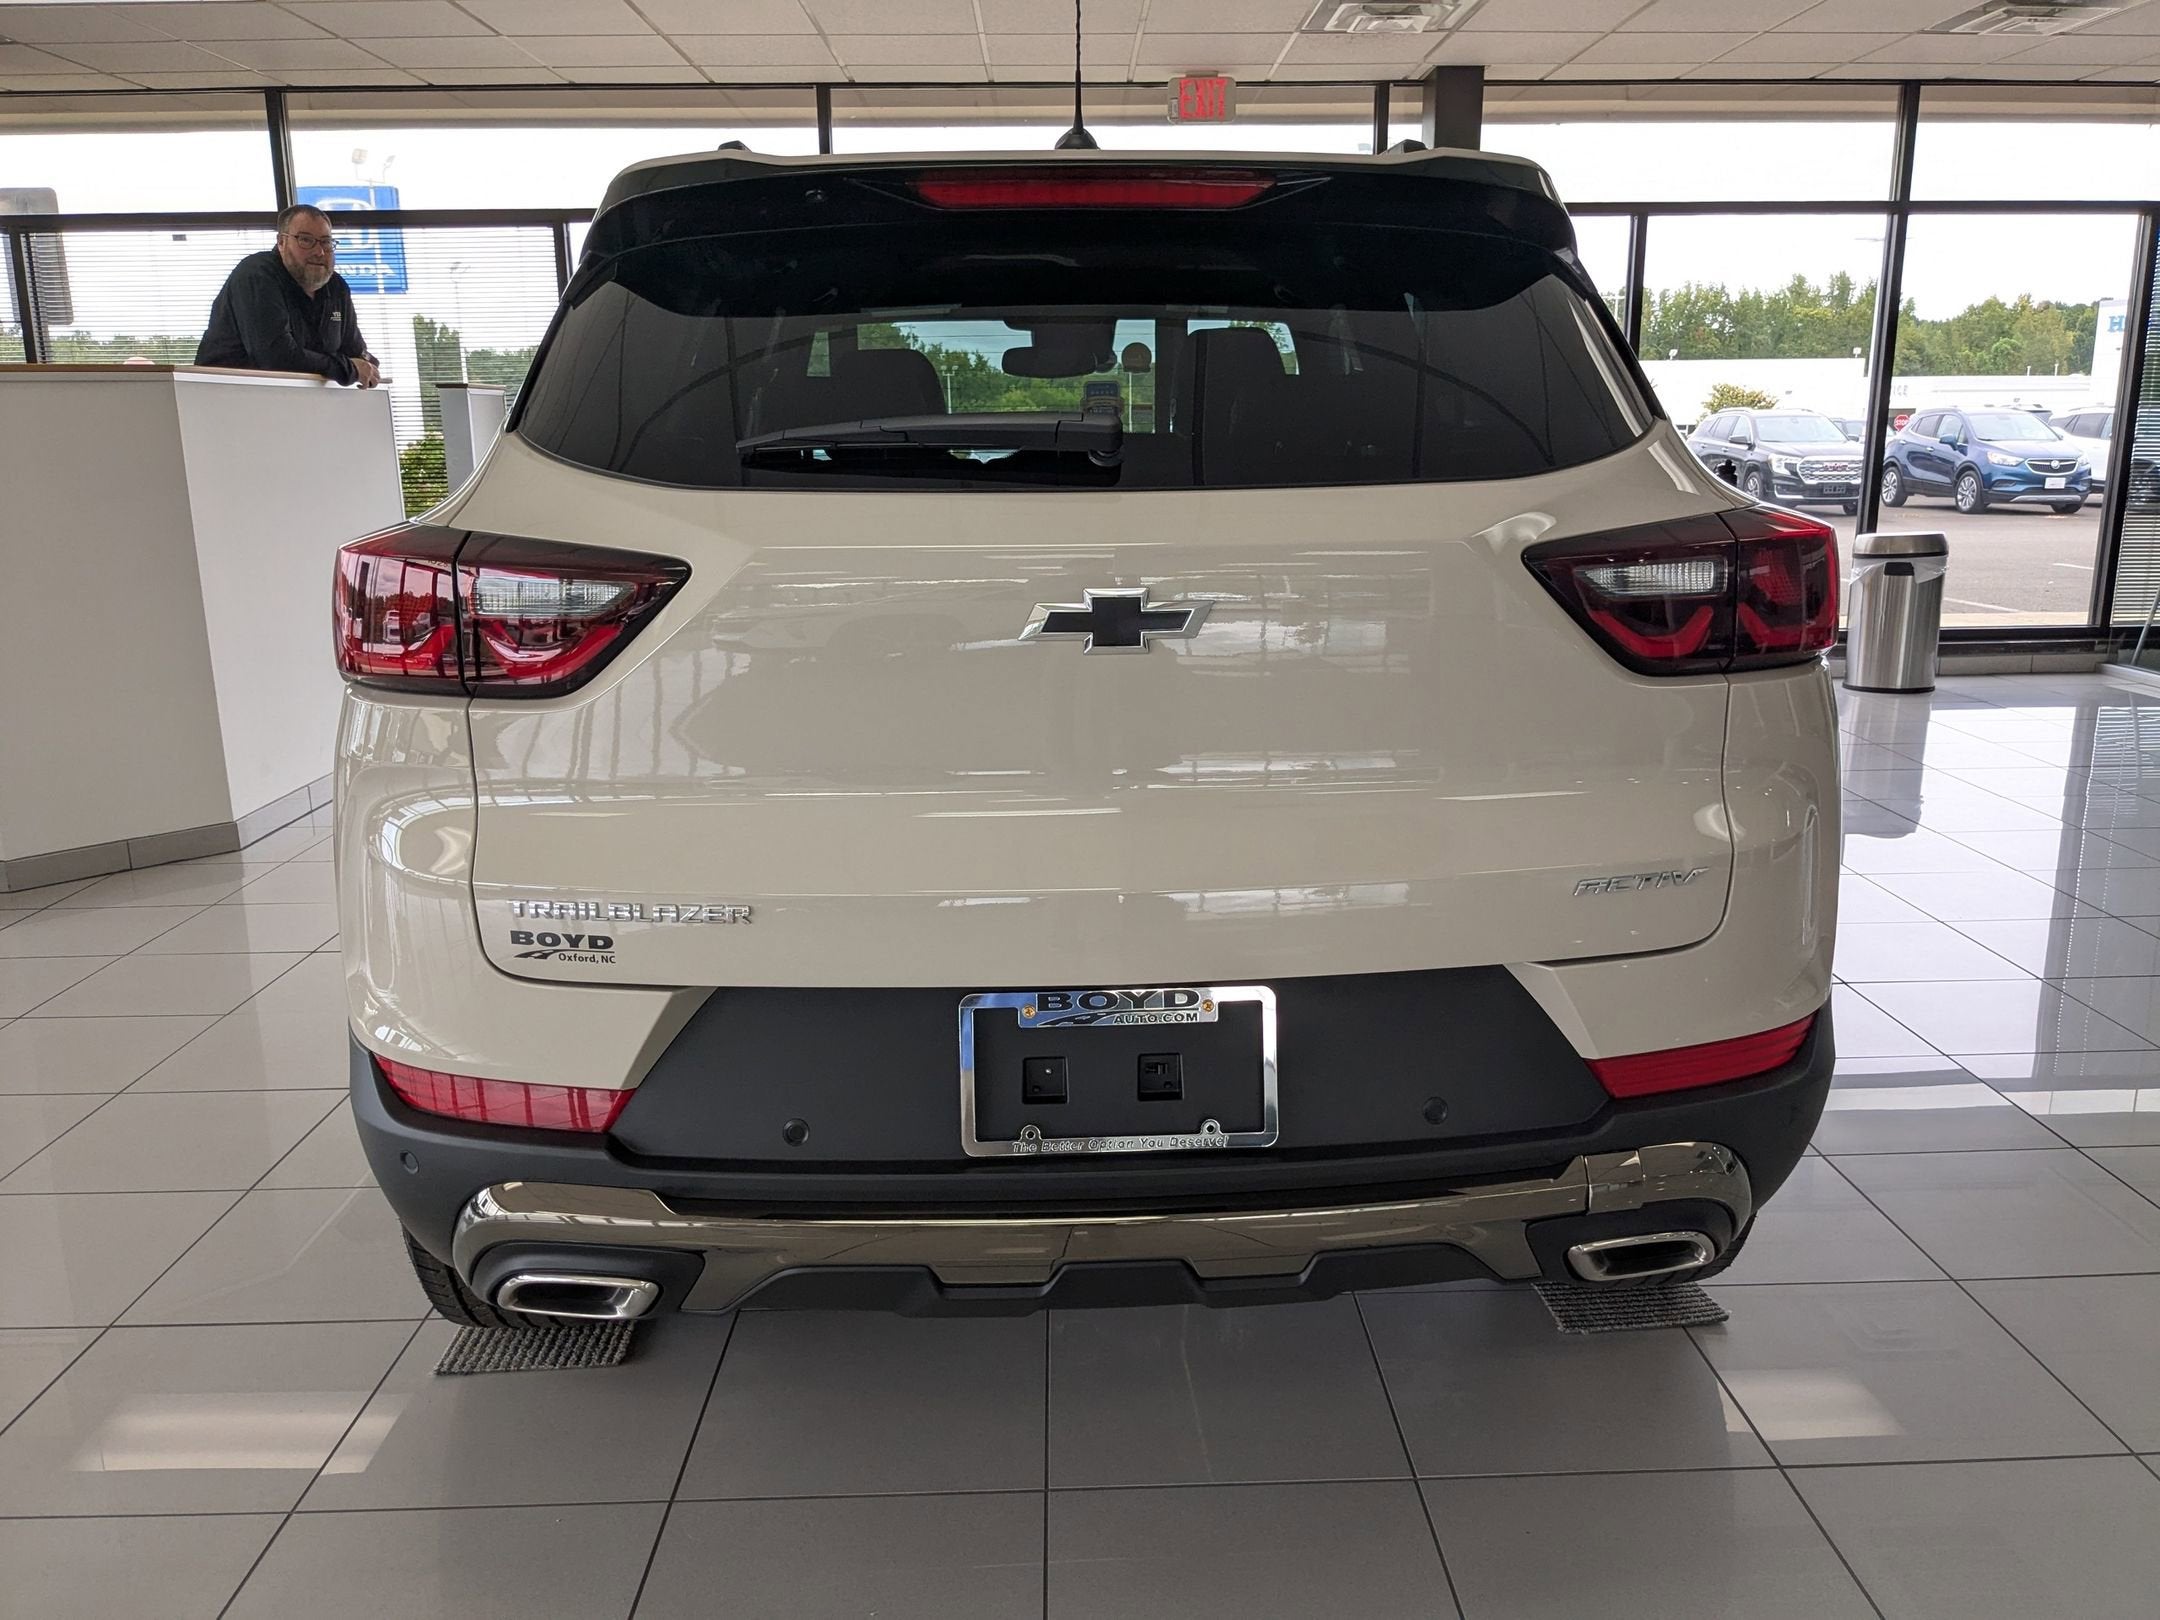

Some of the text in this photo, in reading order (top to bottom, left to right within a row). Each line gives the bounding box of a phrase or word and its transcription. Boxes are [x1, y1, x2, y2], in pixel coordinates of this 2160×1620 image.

[1180, 79, 1226, 119] EXIT
[1573, 867, 1709, 896] ACTIV
[507, 899, 752, 925] TRAILBLAZER
[510, 930, 614, 950] BOYD
[558, 952, 616, 965] Oxford, NC
[1036, 989, 1200, 1012] BOYD
[1113, 1012, 1199, 1025] AUTO.COM
[1012, 1141, 1037, 1152] The
[1041, 1140, 1084, 1151] Better
[1088, 1137, 1134, 1152] Option
[1139, 1137, 1163, 1149] You
